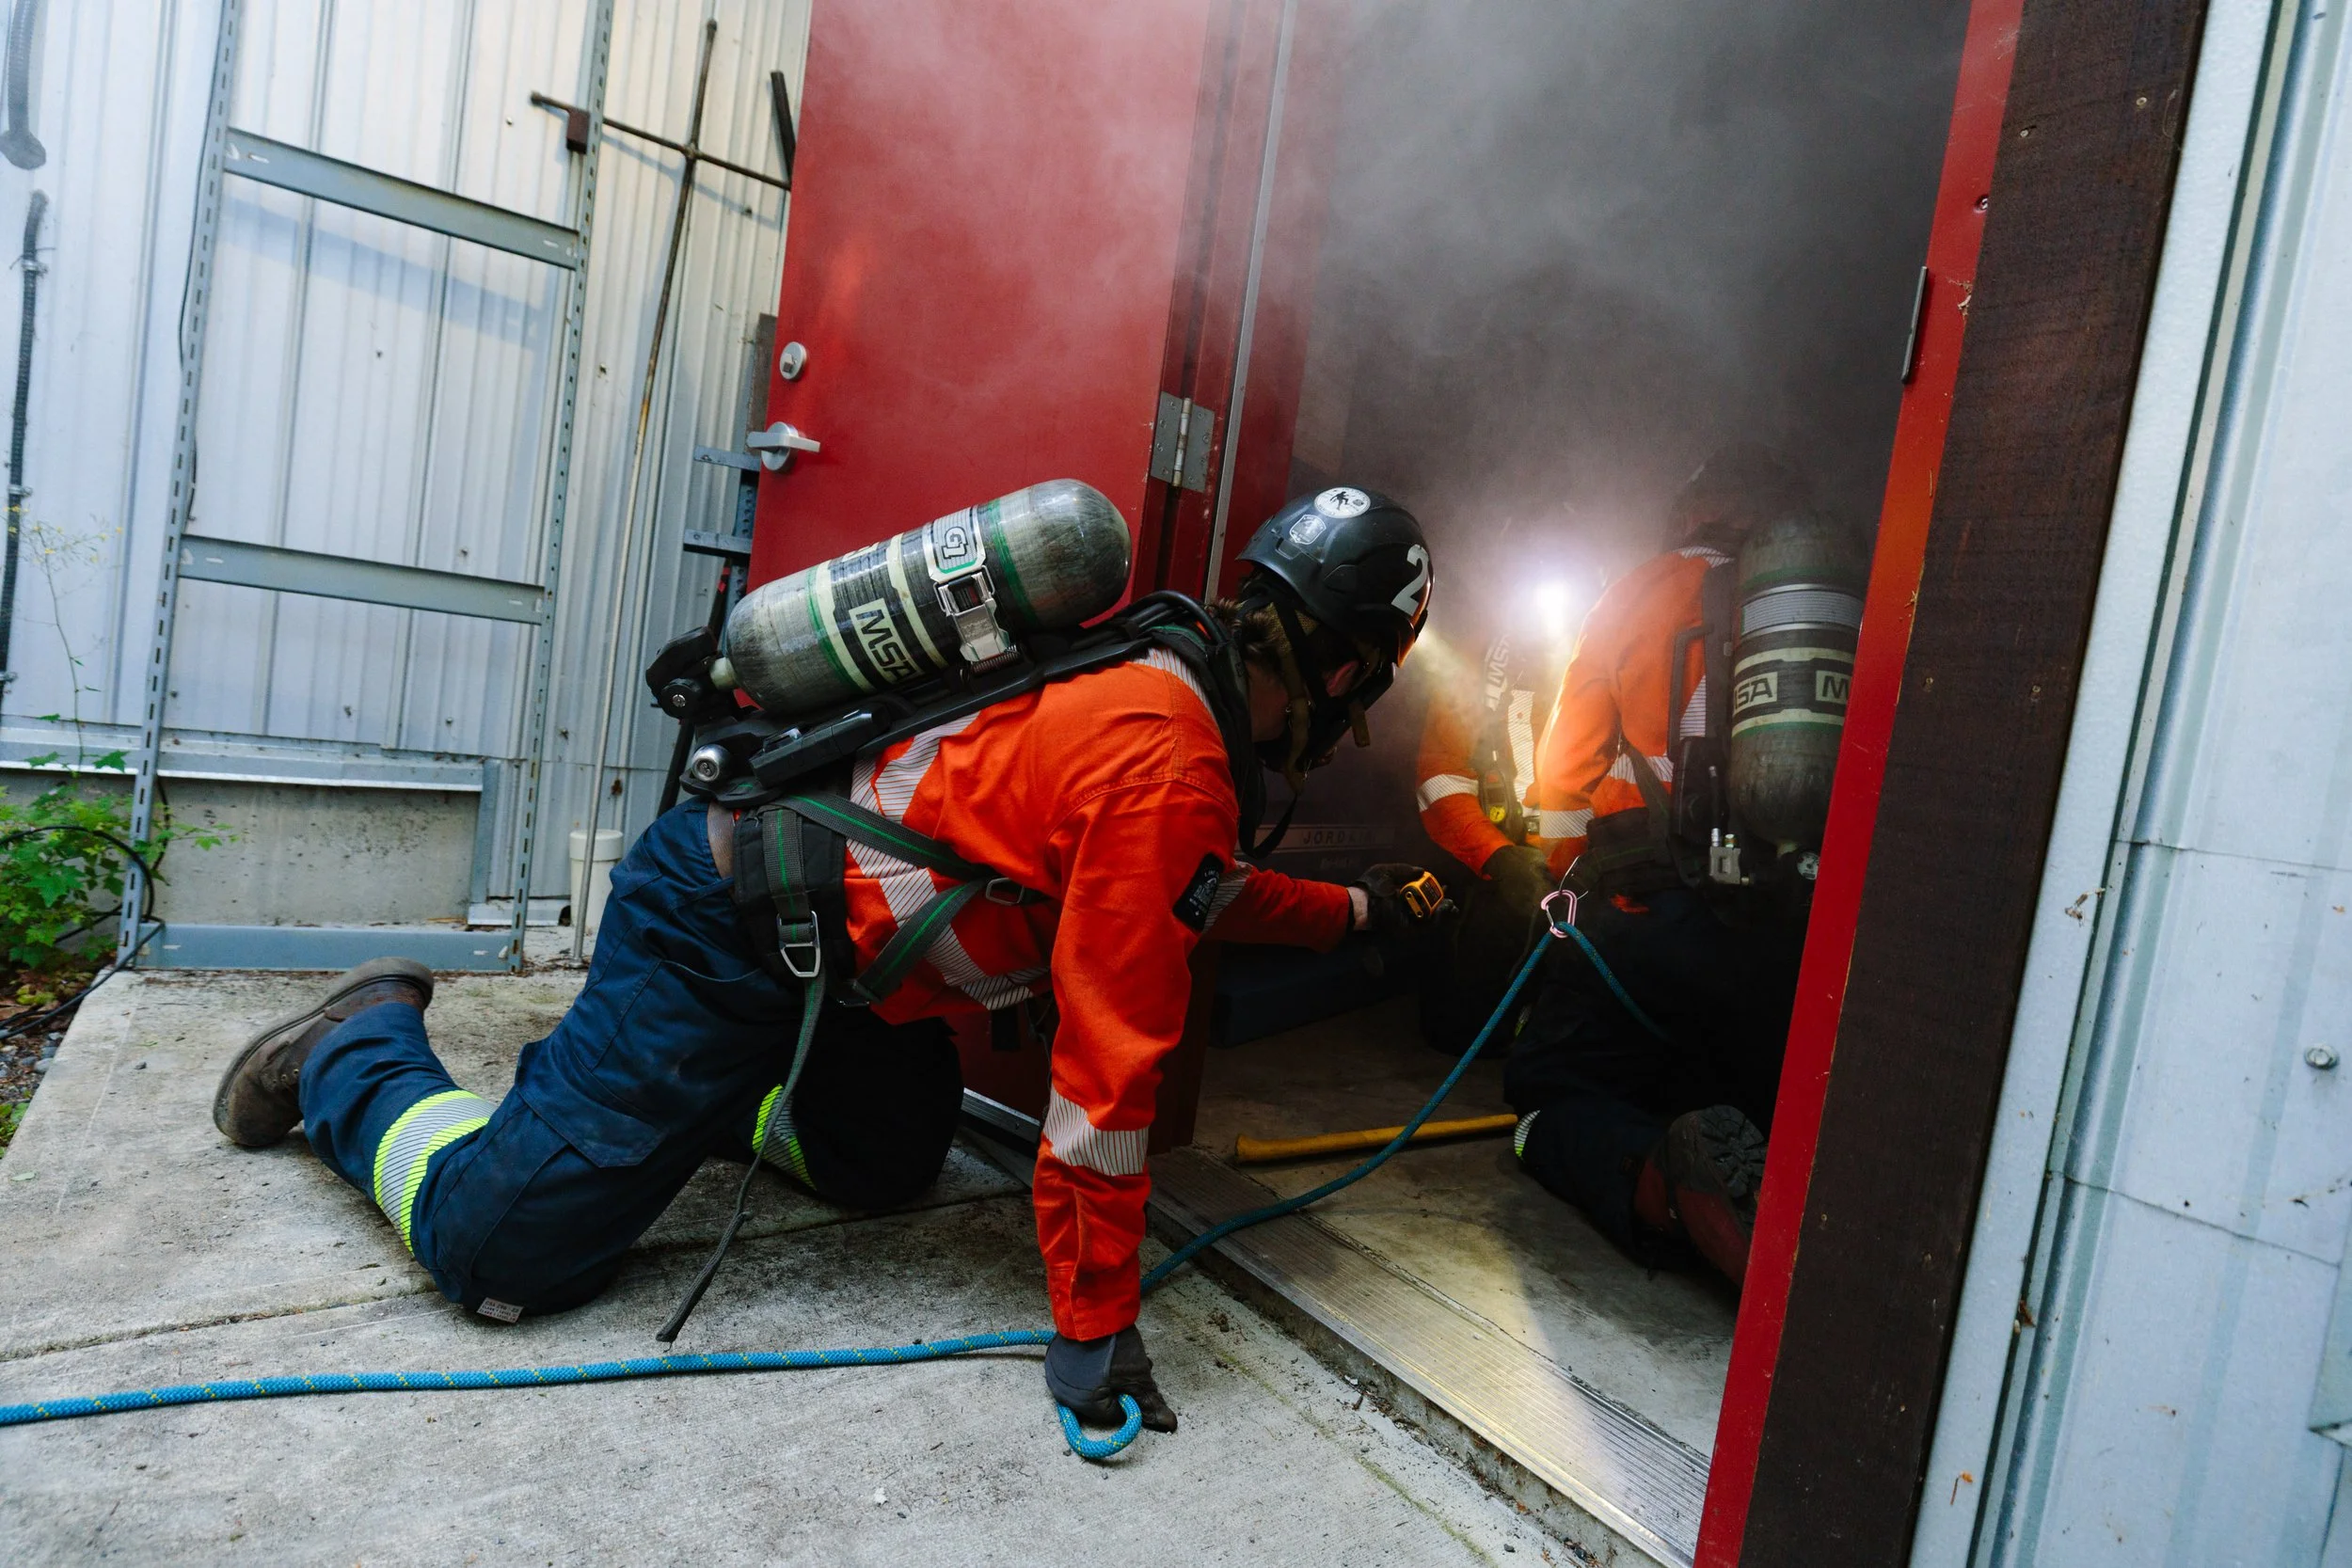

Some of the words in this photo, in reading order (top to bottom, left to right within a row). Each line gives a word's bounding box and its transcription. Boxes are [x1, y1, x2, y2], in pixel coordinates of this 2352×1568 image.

[942, 527, 968, 559] G1
[1391, 544, 1429, 616] 2
[855, 610, 916, 680] MSA
[1735, 678, 1772, 709] SA
